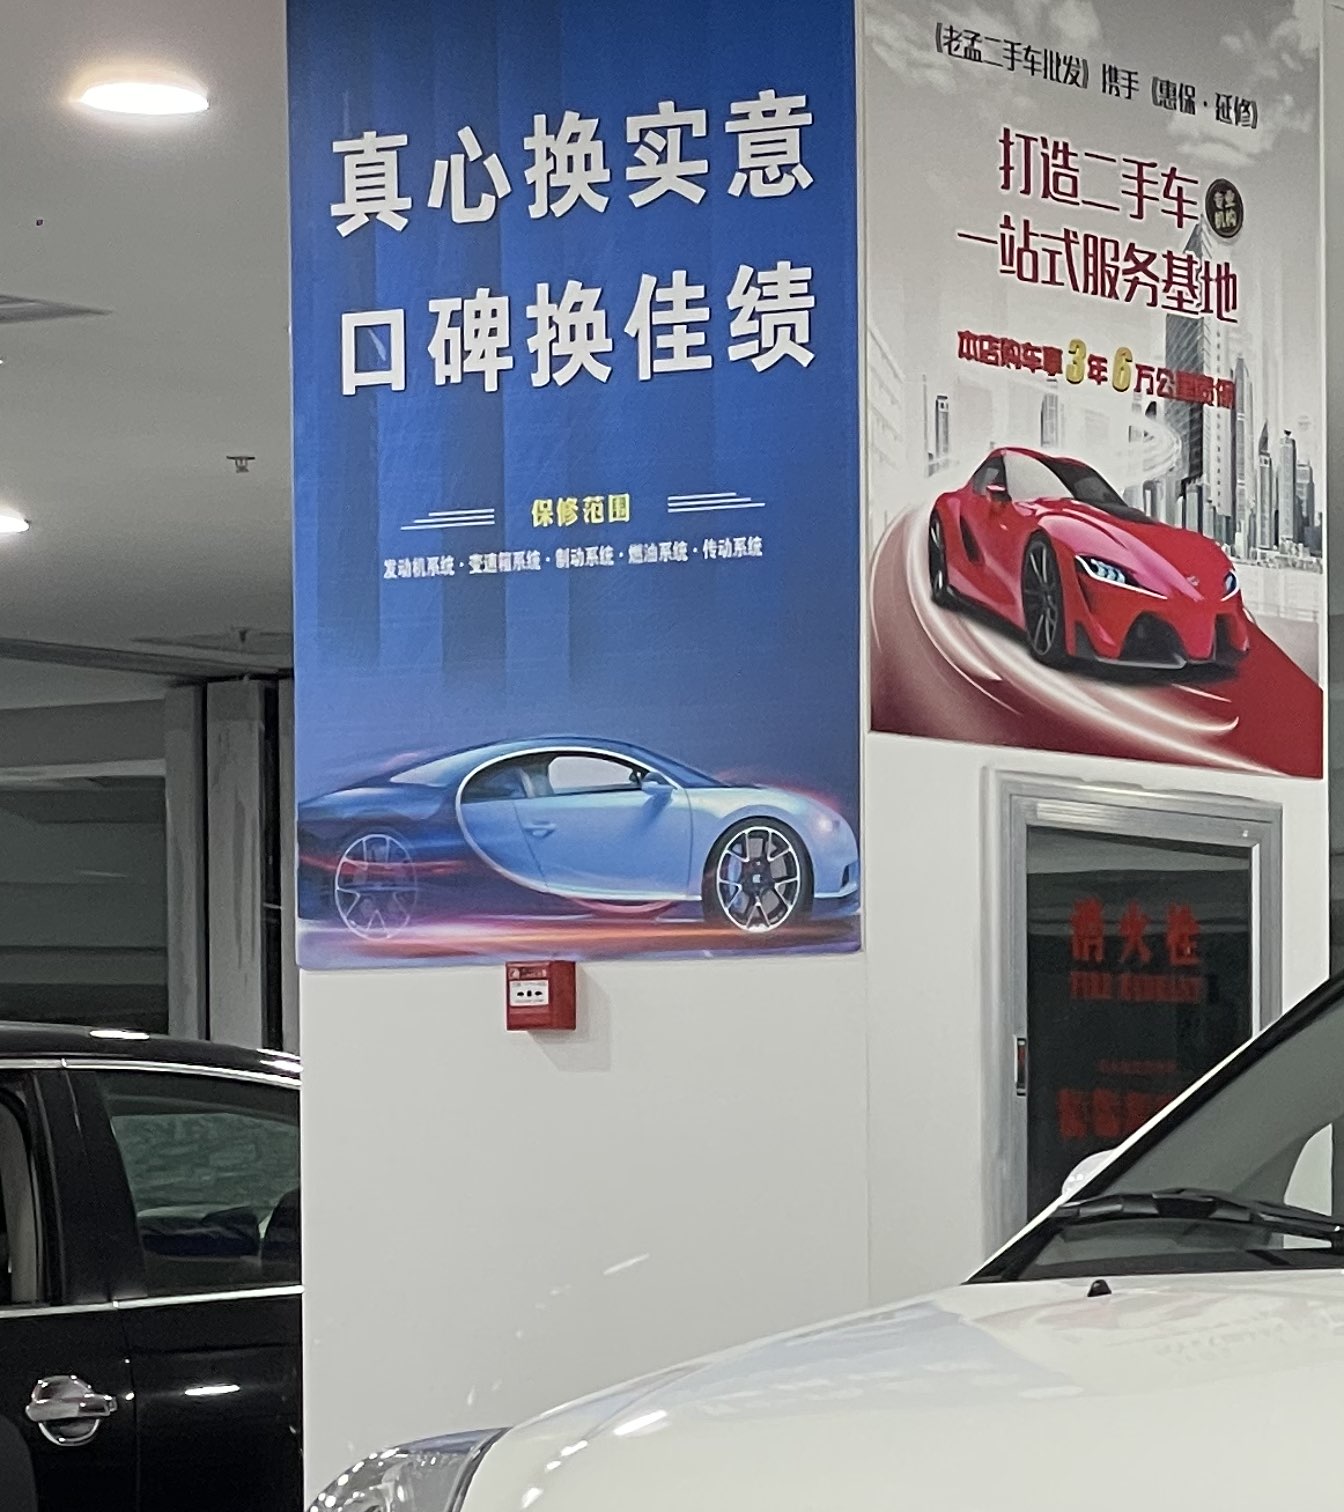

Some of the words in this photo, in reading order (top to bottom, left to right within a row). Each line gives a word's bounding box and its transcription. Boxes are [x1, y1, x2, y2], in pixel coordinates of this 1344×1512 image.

[1101, 63, 1140, 100] 携手
[330, 88, 814, 238] 真心换实意
[998, 127, 1200, 229] 打造二手车
[957, 214, 1239, 324] 一站式服务基地
[340, 260, 816, 397] 口碑换佳绩
[531, 492, 632, 528] 保修范围
